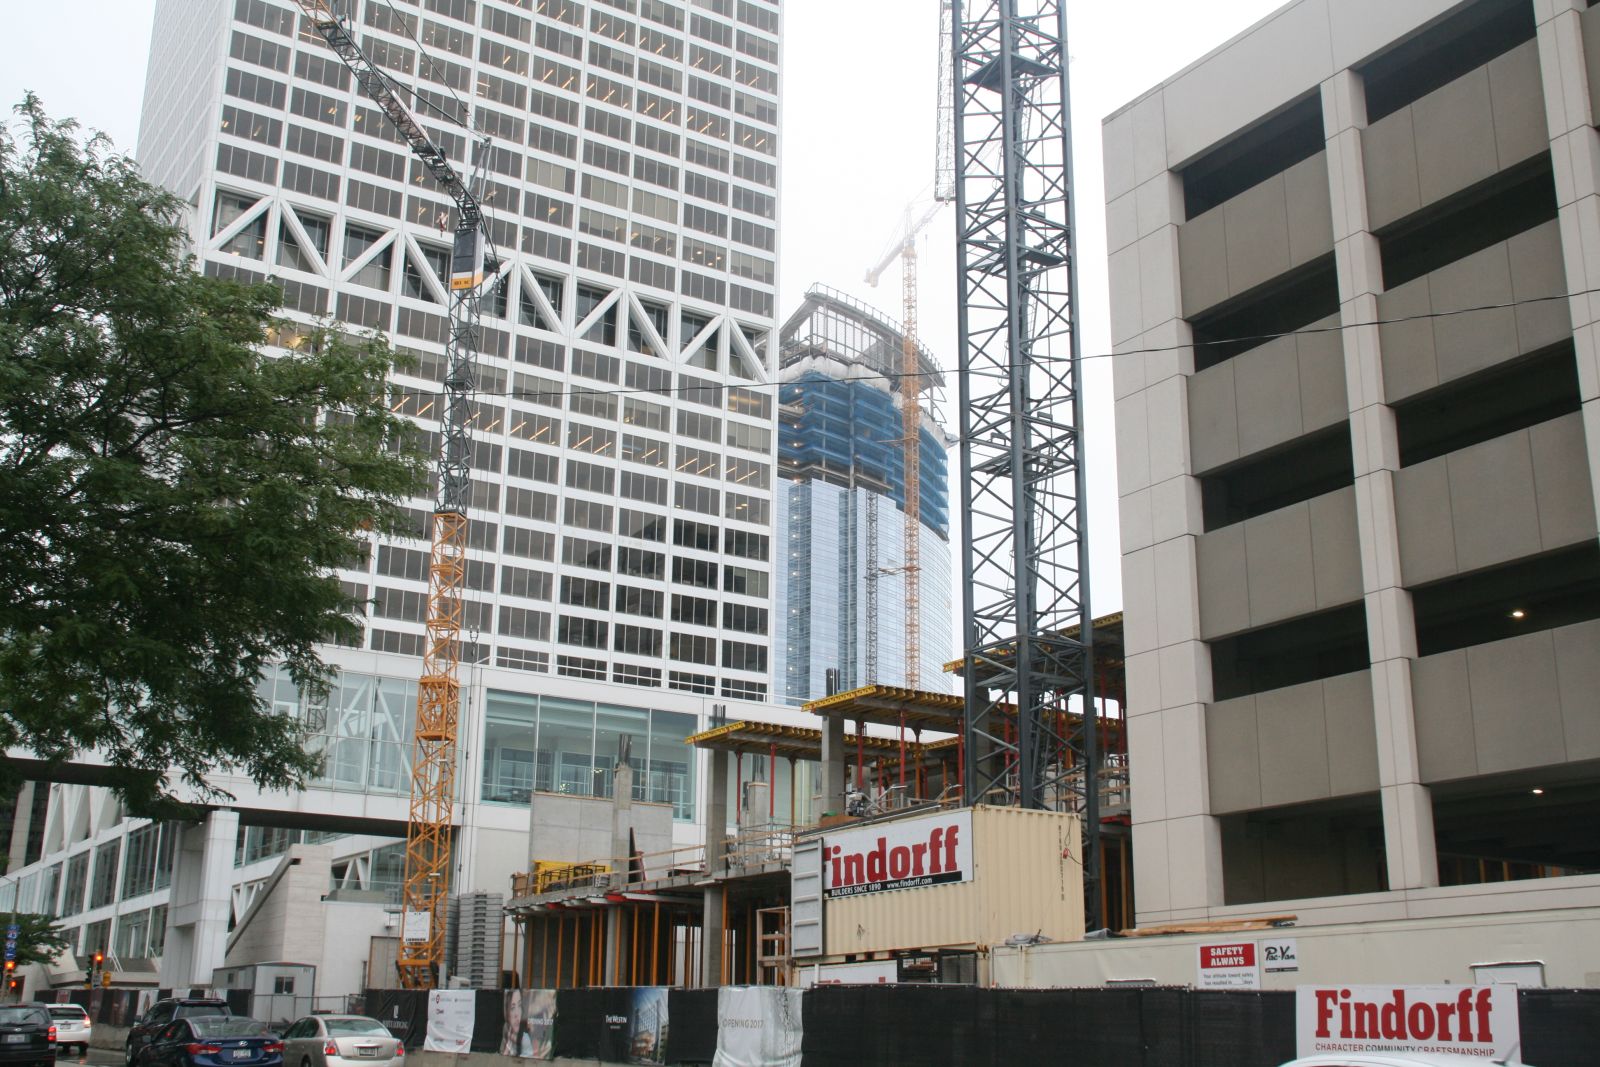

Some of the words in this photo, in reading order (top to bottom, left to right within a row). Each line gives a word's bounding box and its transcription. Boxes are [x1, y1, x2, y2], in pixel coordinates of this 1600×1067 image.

[831, 886, 854, 897] BUILDERS
[853, 885, 868, 894] SINCE
[868, 882, 881, 892] 1890
[886, 877, 933, 889] www.findorff.com
[1210, 946, 1244, 956] SAFETY
[1265, 945, 1295, 961] Pac-Van
[1210, 956, 1245, 967] ALWAYS
[1314, 988, 1493, 1042] Findorff
[722, 1018, 750, 1028] OPENING
[750, 1019, 765, 1029] 2017
[1315, 1043, 1364, 1052] CHARACTER
[1417, 1046, 1495, 1057] CRAFTSMANSHIP
